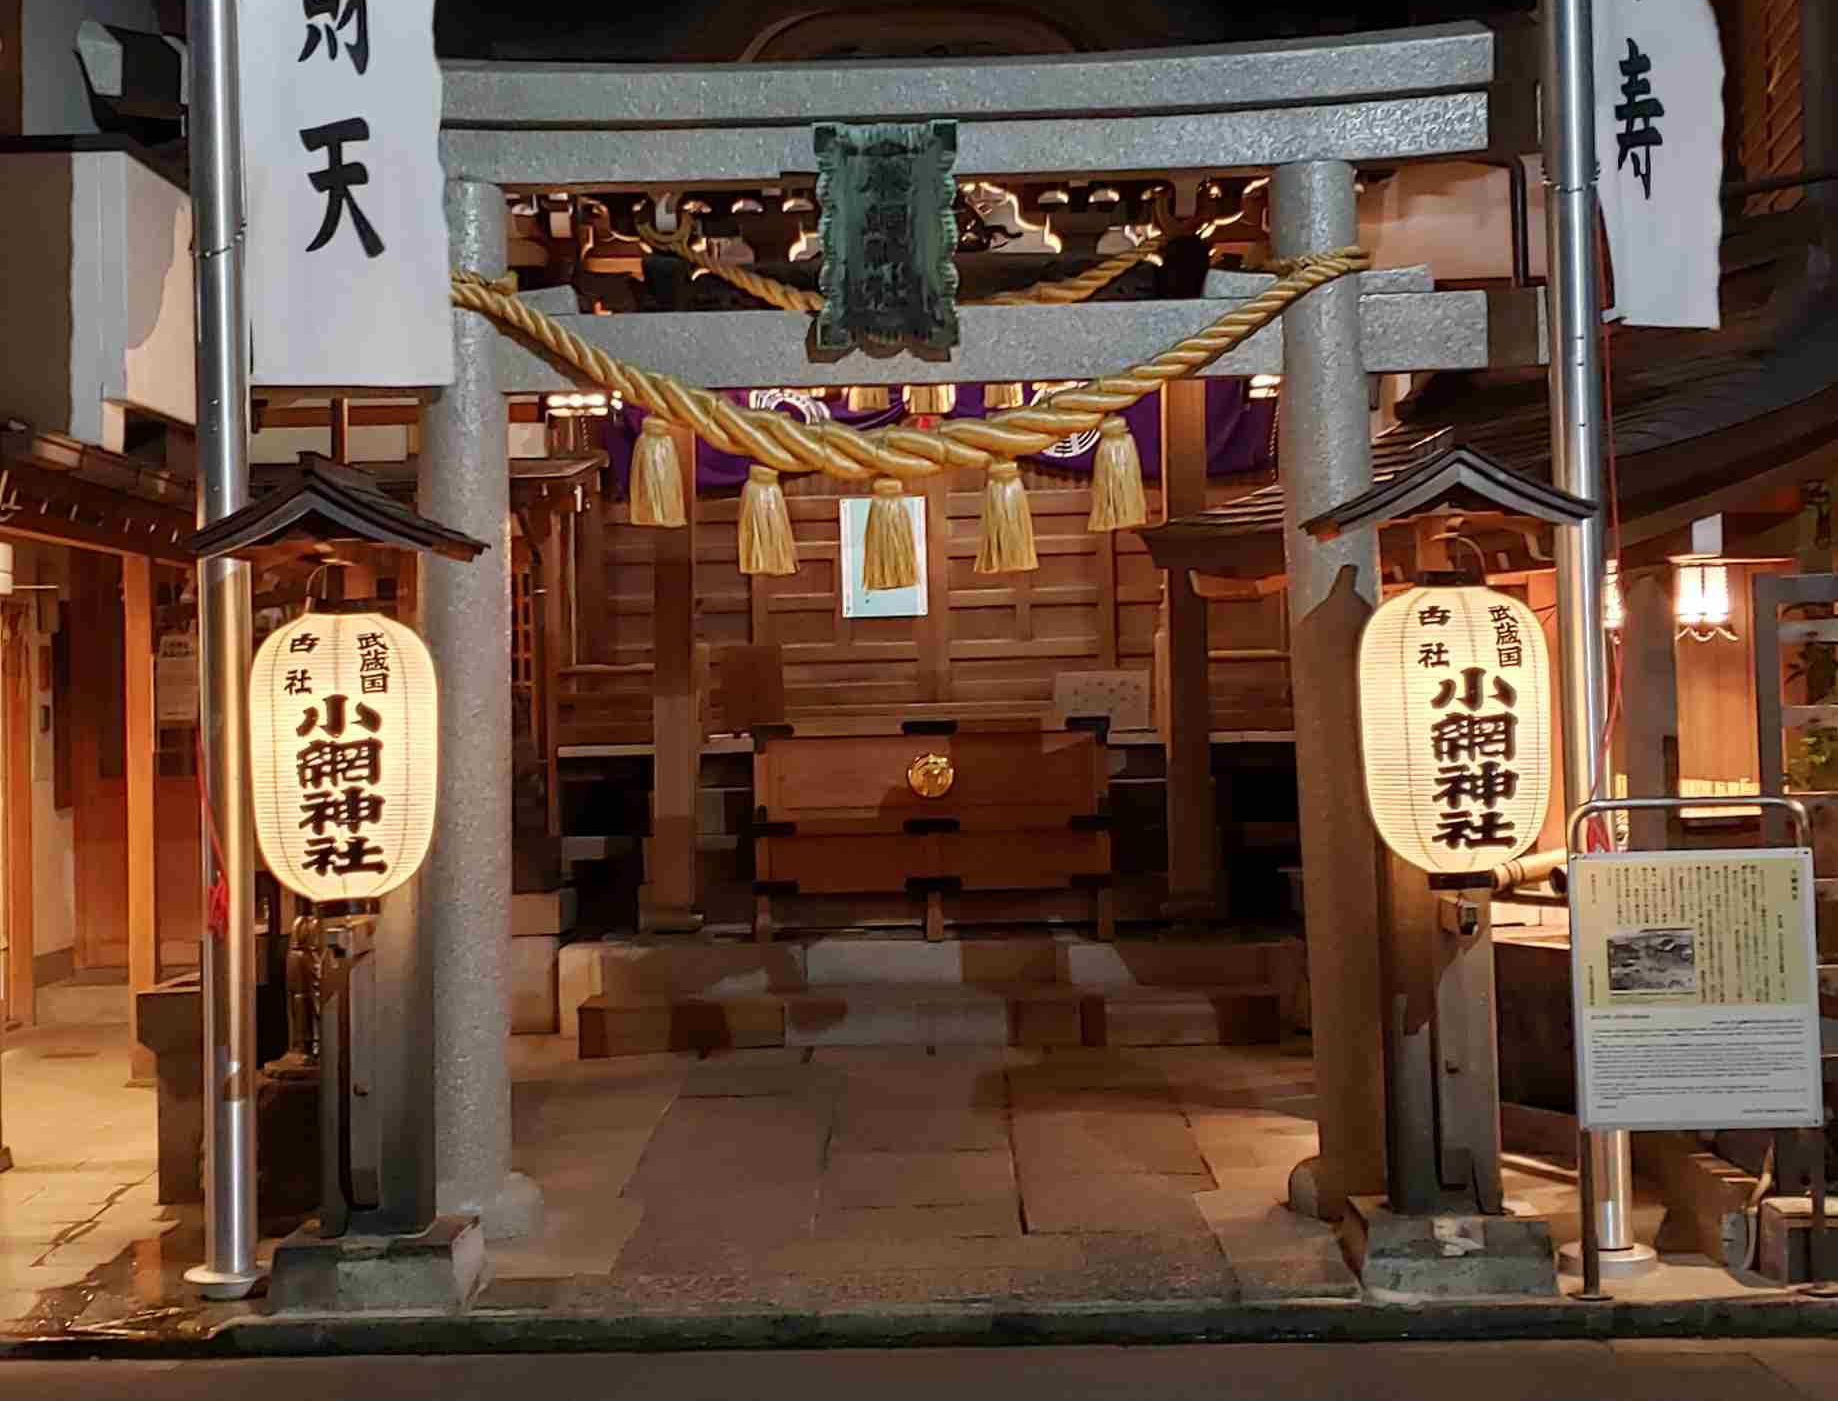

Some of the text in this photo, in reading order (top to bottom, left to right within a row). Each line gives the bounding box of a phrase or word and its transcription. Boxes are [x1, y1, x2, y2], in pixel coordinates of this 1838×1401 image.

[357, 632, 390, 695] 武蔵国
[1488, 605, 1523, 668] 武蔵国
[295, 694, 389, 877] 小網神社
[1430, 666, 1520, 850] 小網神社
